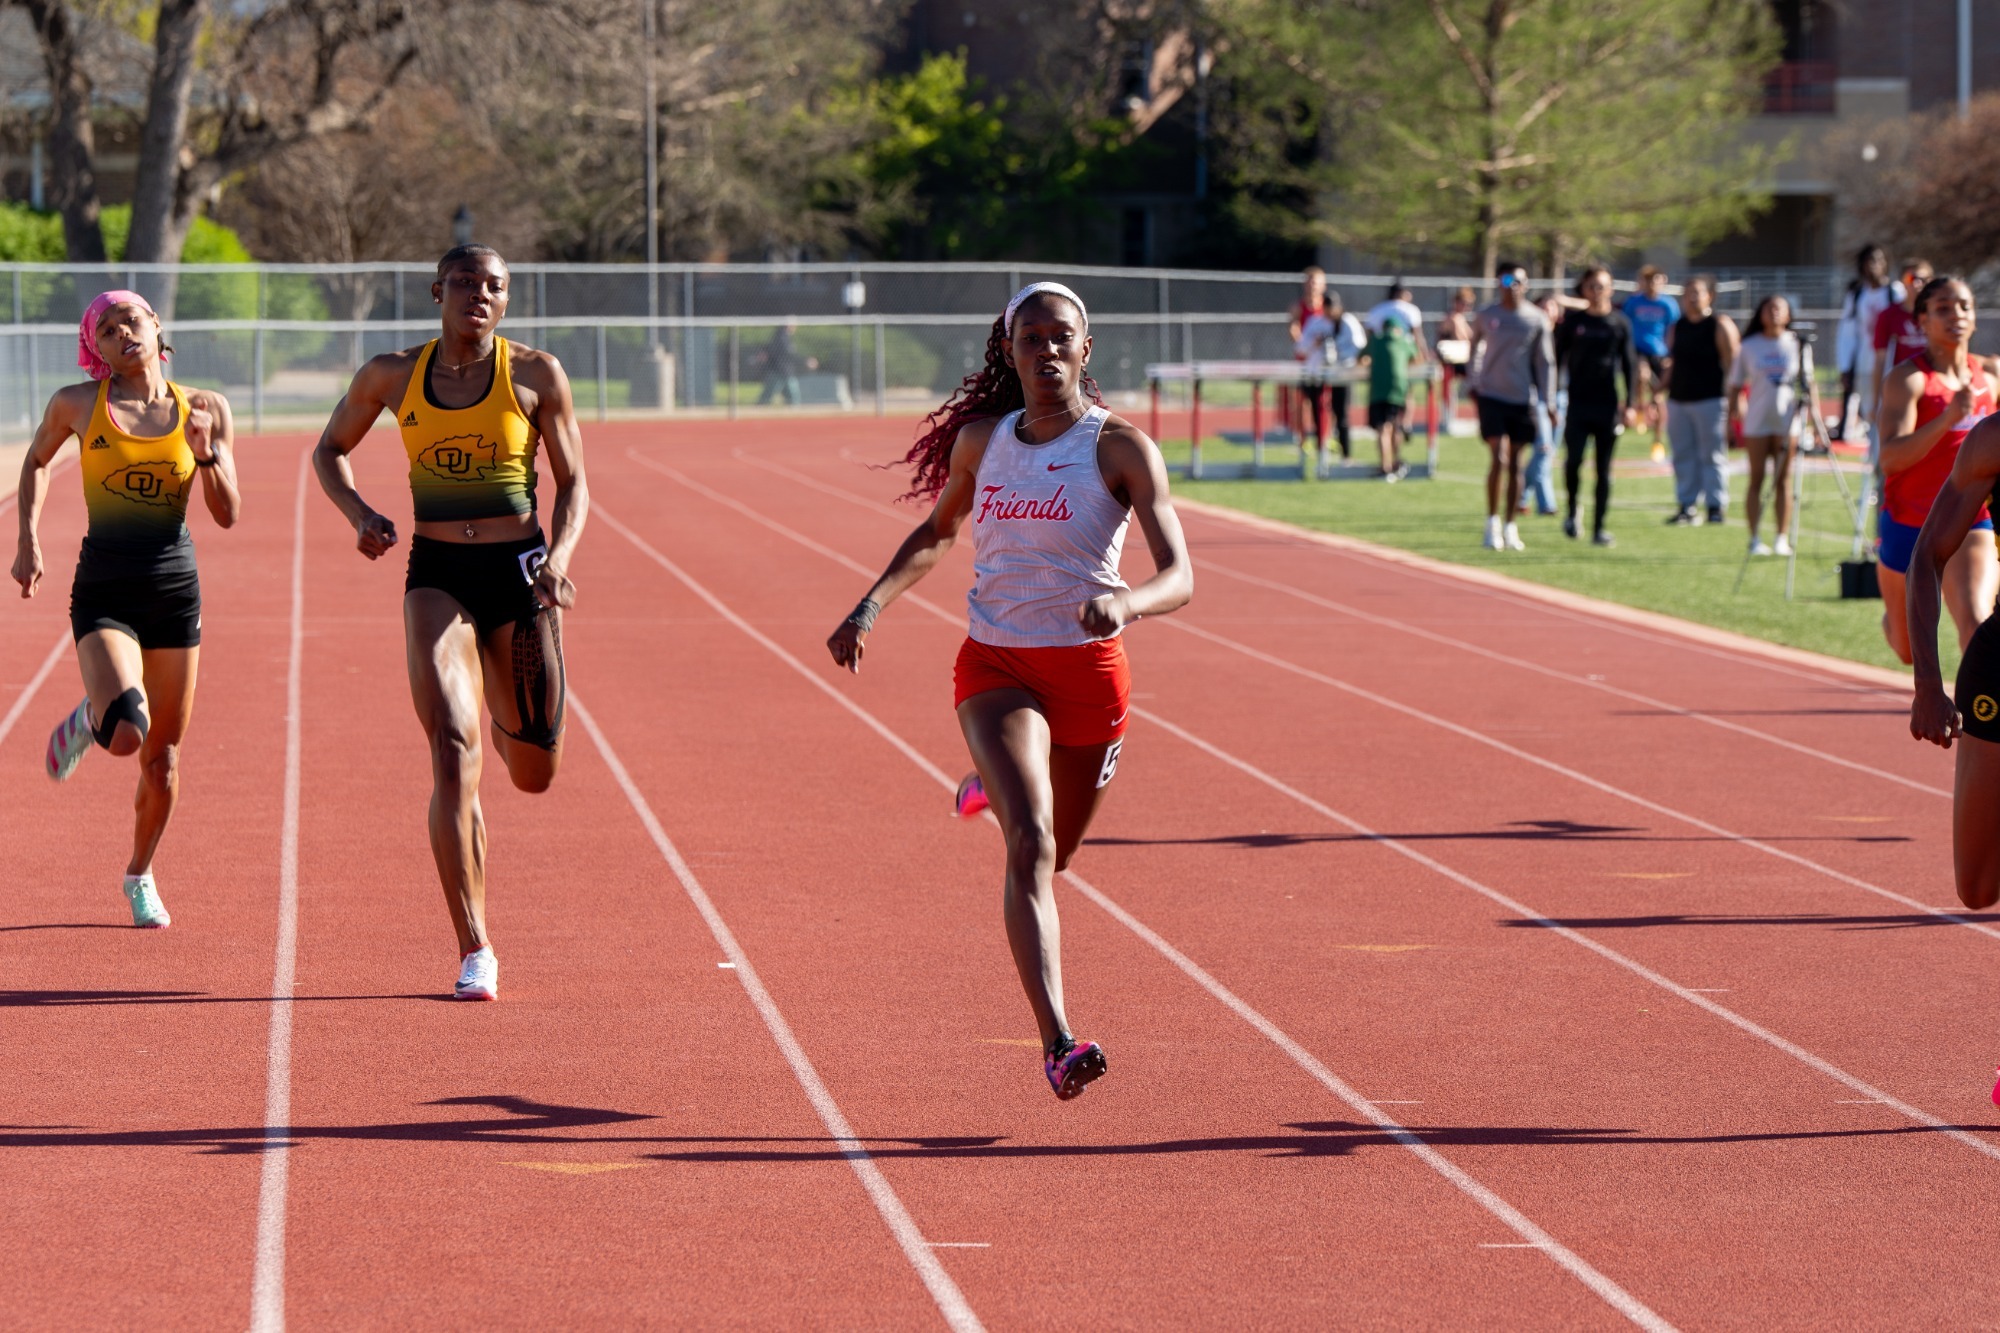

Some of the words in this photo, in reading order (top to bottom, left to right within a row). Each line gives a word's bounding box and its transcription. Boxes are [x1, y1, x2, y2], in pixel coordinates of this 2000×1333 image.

[435, 448, 472, 473] OU
[126, 471, 163, 498] OU
[976, 483, 1074, 524] Friends
[1103, 743, 1122, 781] 5
